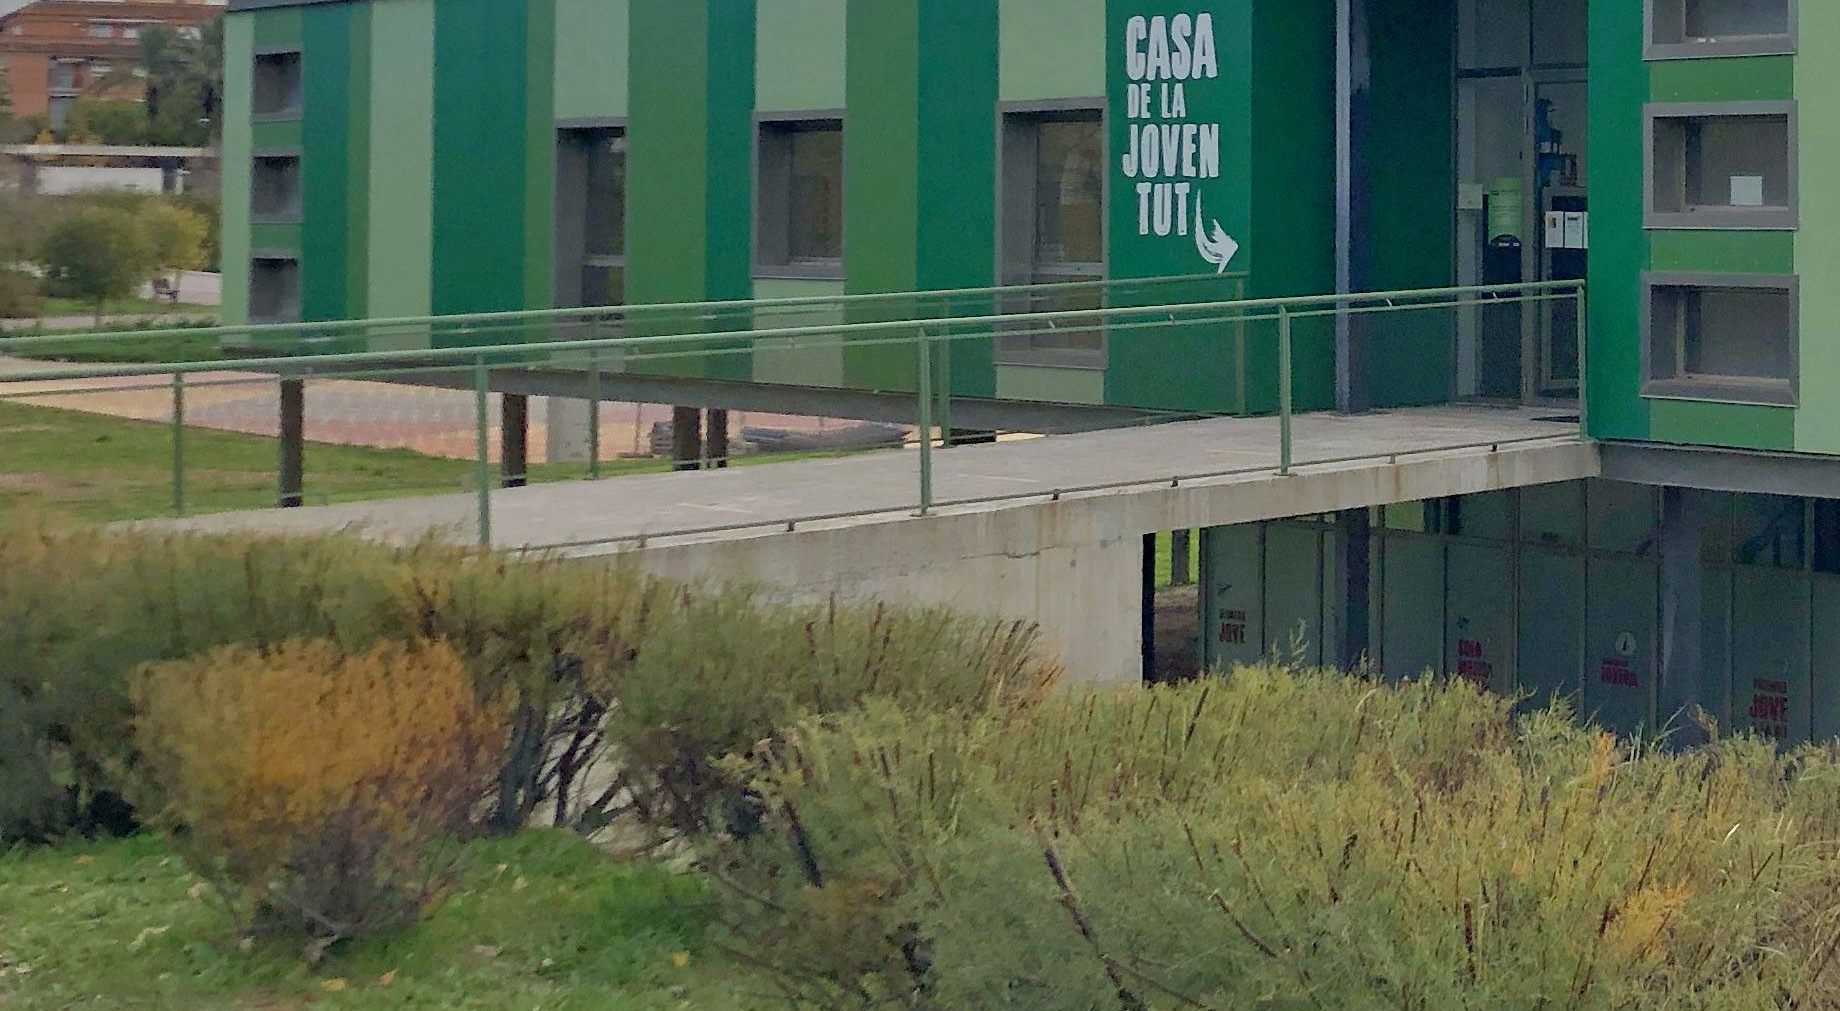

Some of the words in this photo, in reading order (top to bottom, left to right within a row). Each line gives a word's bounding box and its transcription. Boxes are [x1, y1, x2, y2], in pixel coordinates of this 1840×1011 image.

[1126, 13, 1218, 81] CASA
[1127, 83, 1151, 118] DE
[1161, 82, 1186, 118] LA
[1122, 123, 1219, 178] JOVEN
[1136, 182, 1190, 235] TUT
